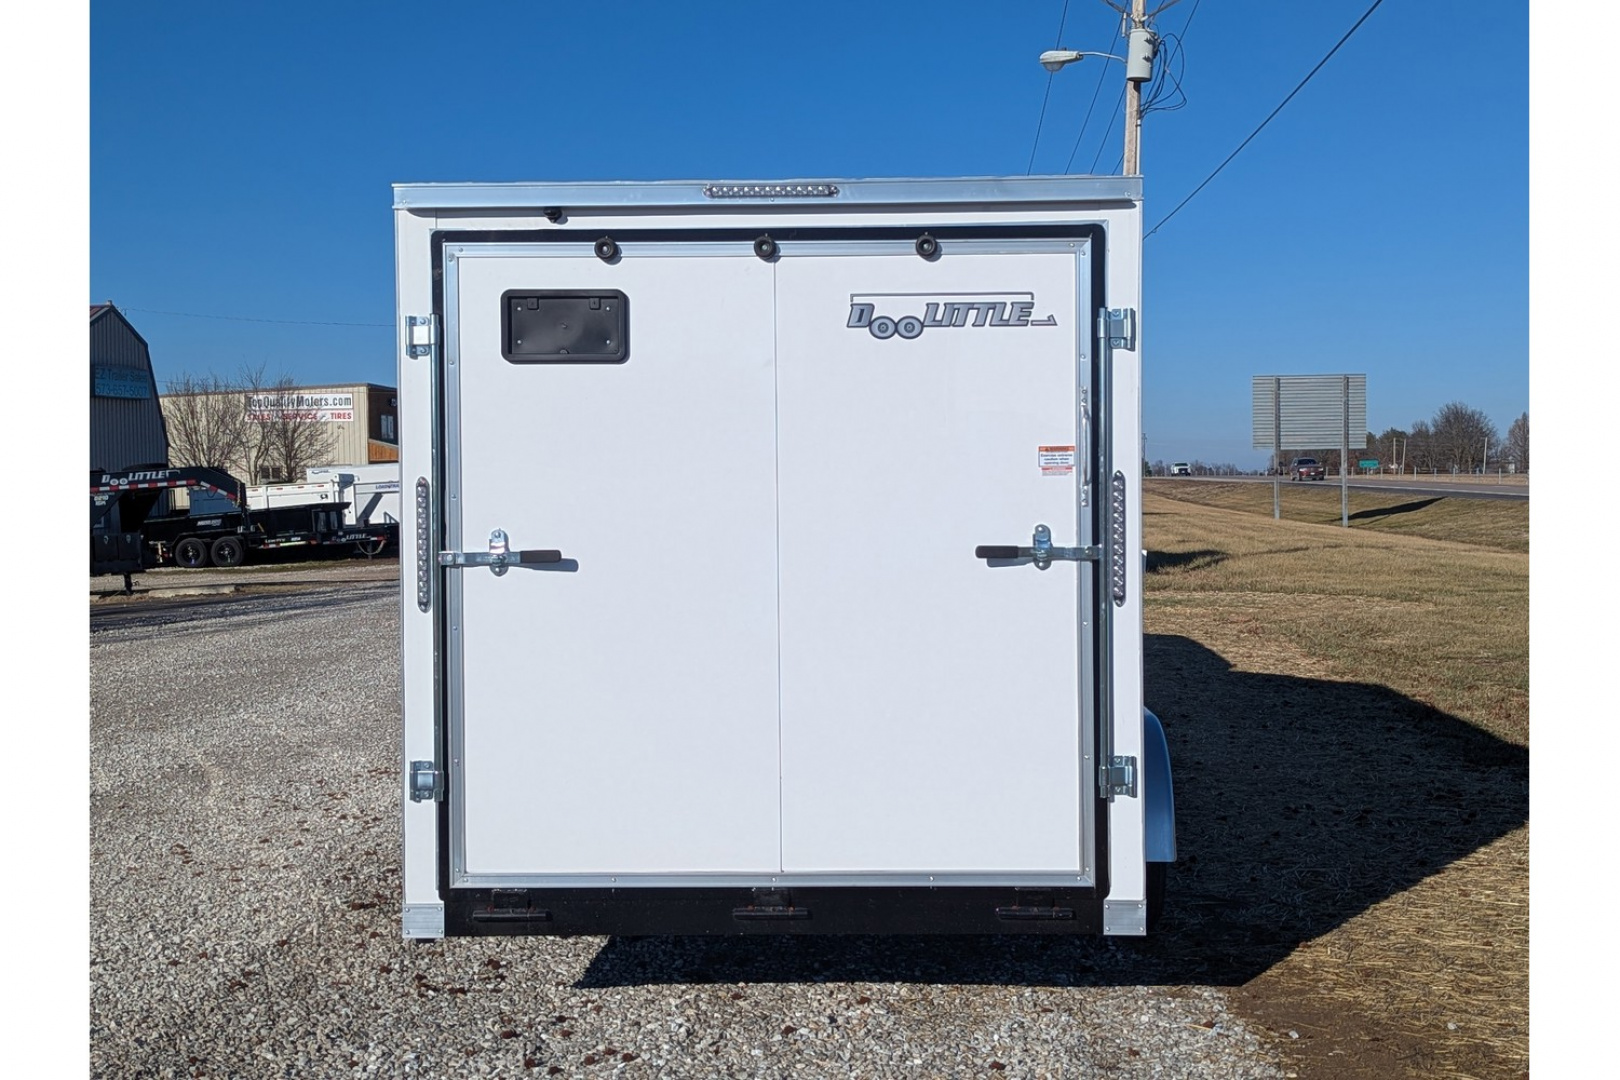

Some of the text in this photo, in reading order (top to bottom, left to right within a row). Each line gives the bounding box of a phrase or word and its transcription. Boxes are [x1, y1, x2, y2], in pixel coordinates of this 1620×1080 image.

[846, 300, 1035, 340] DOOLITTLE
[330, 412, 352, 420] TIRES
[101, 470, 166, 486] DOOLITTLE
